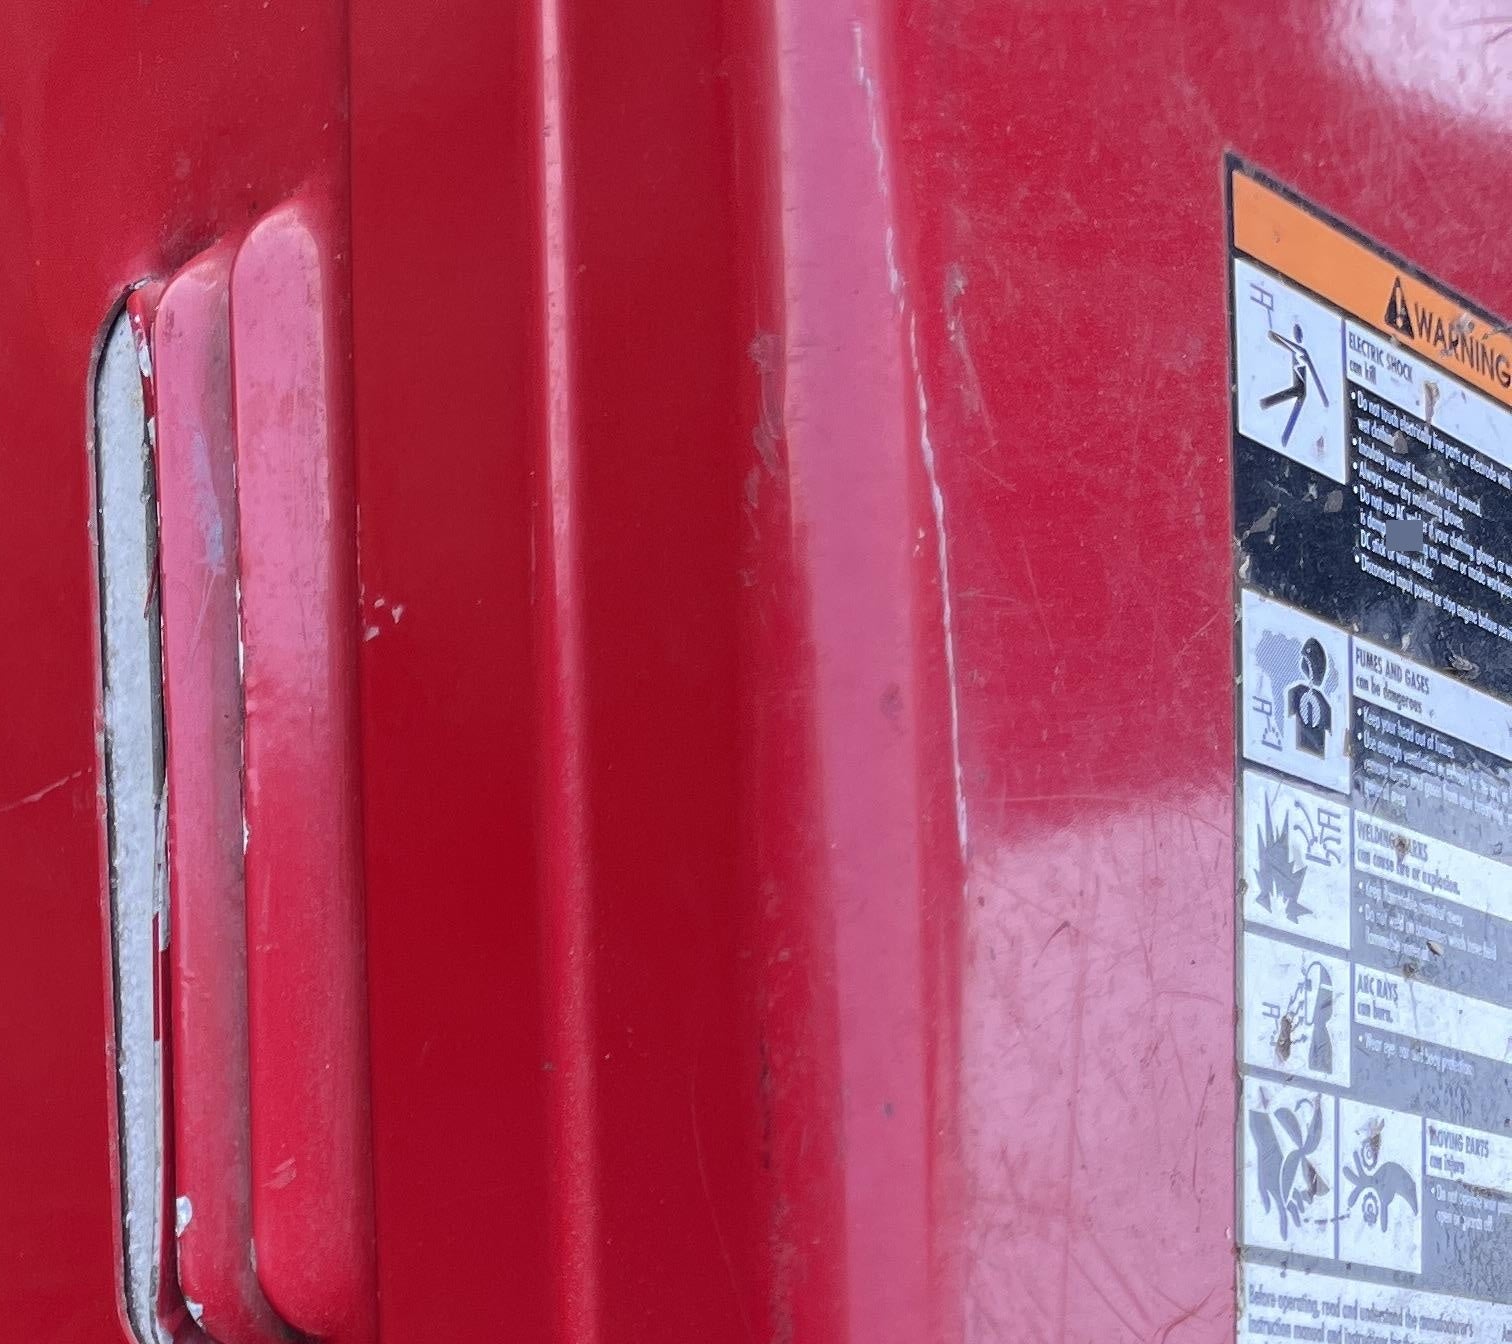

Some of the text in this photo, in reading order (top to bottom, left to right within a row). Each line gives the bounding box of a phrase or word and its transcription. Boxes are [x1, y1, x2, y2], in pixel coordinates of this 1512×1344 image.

[1348, 331, 1413, 383] ELECTRIC SHOCK
[1414, 303, 1511, 389] WARNING
[1355, 646, 1430, 695] FUMES AND GASES
